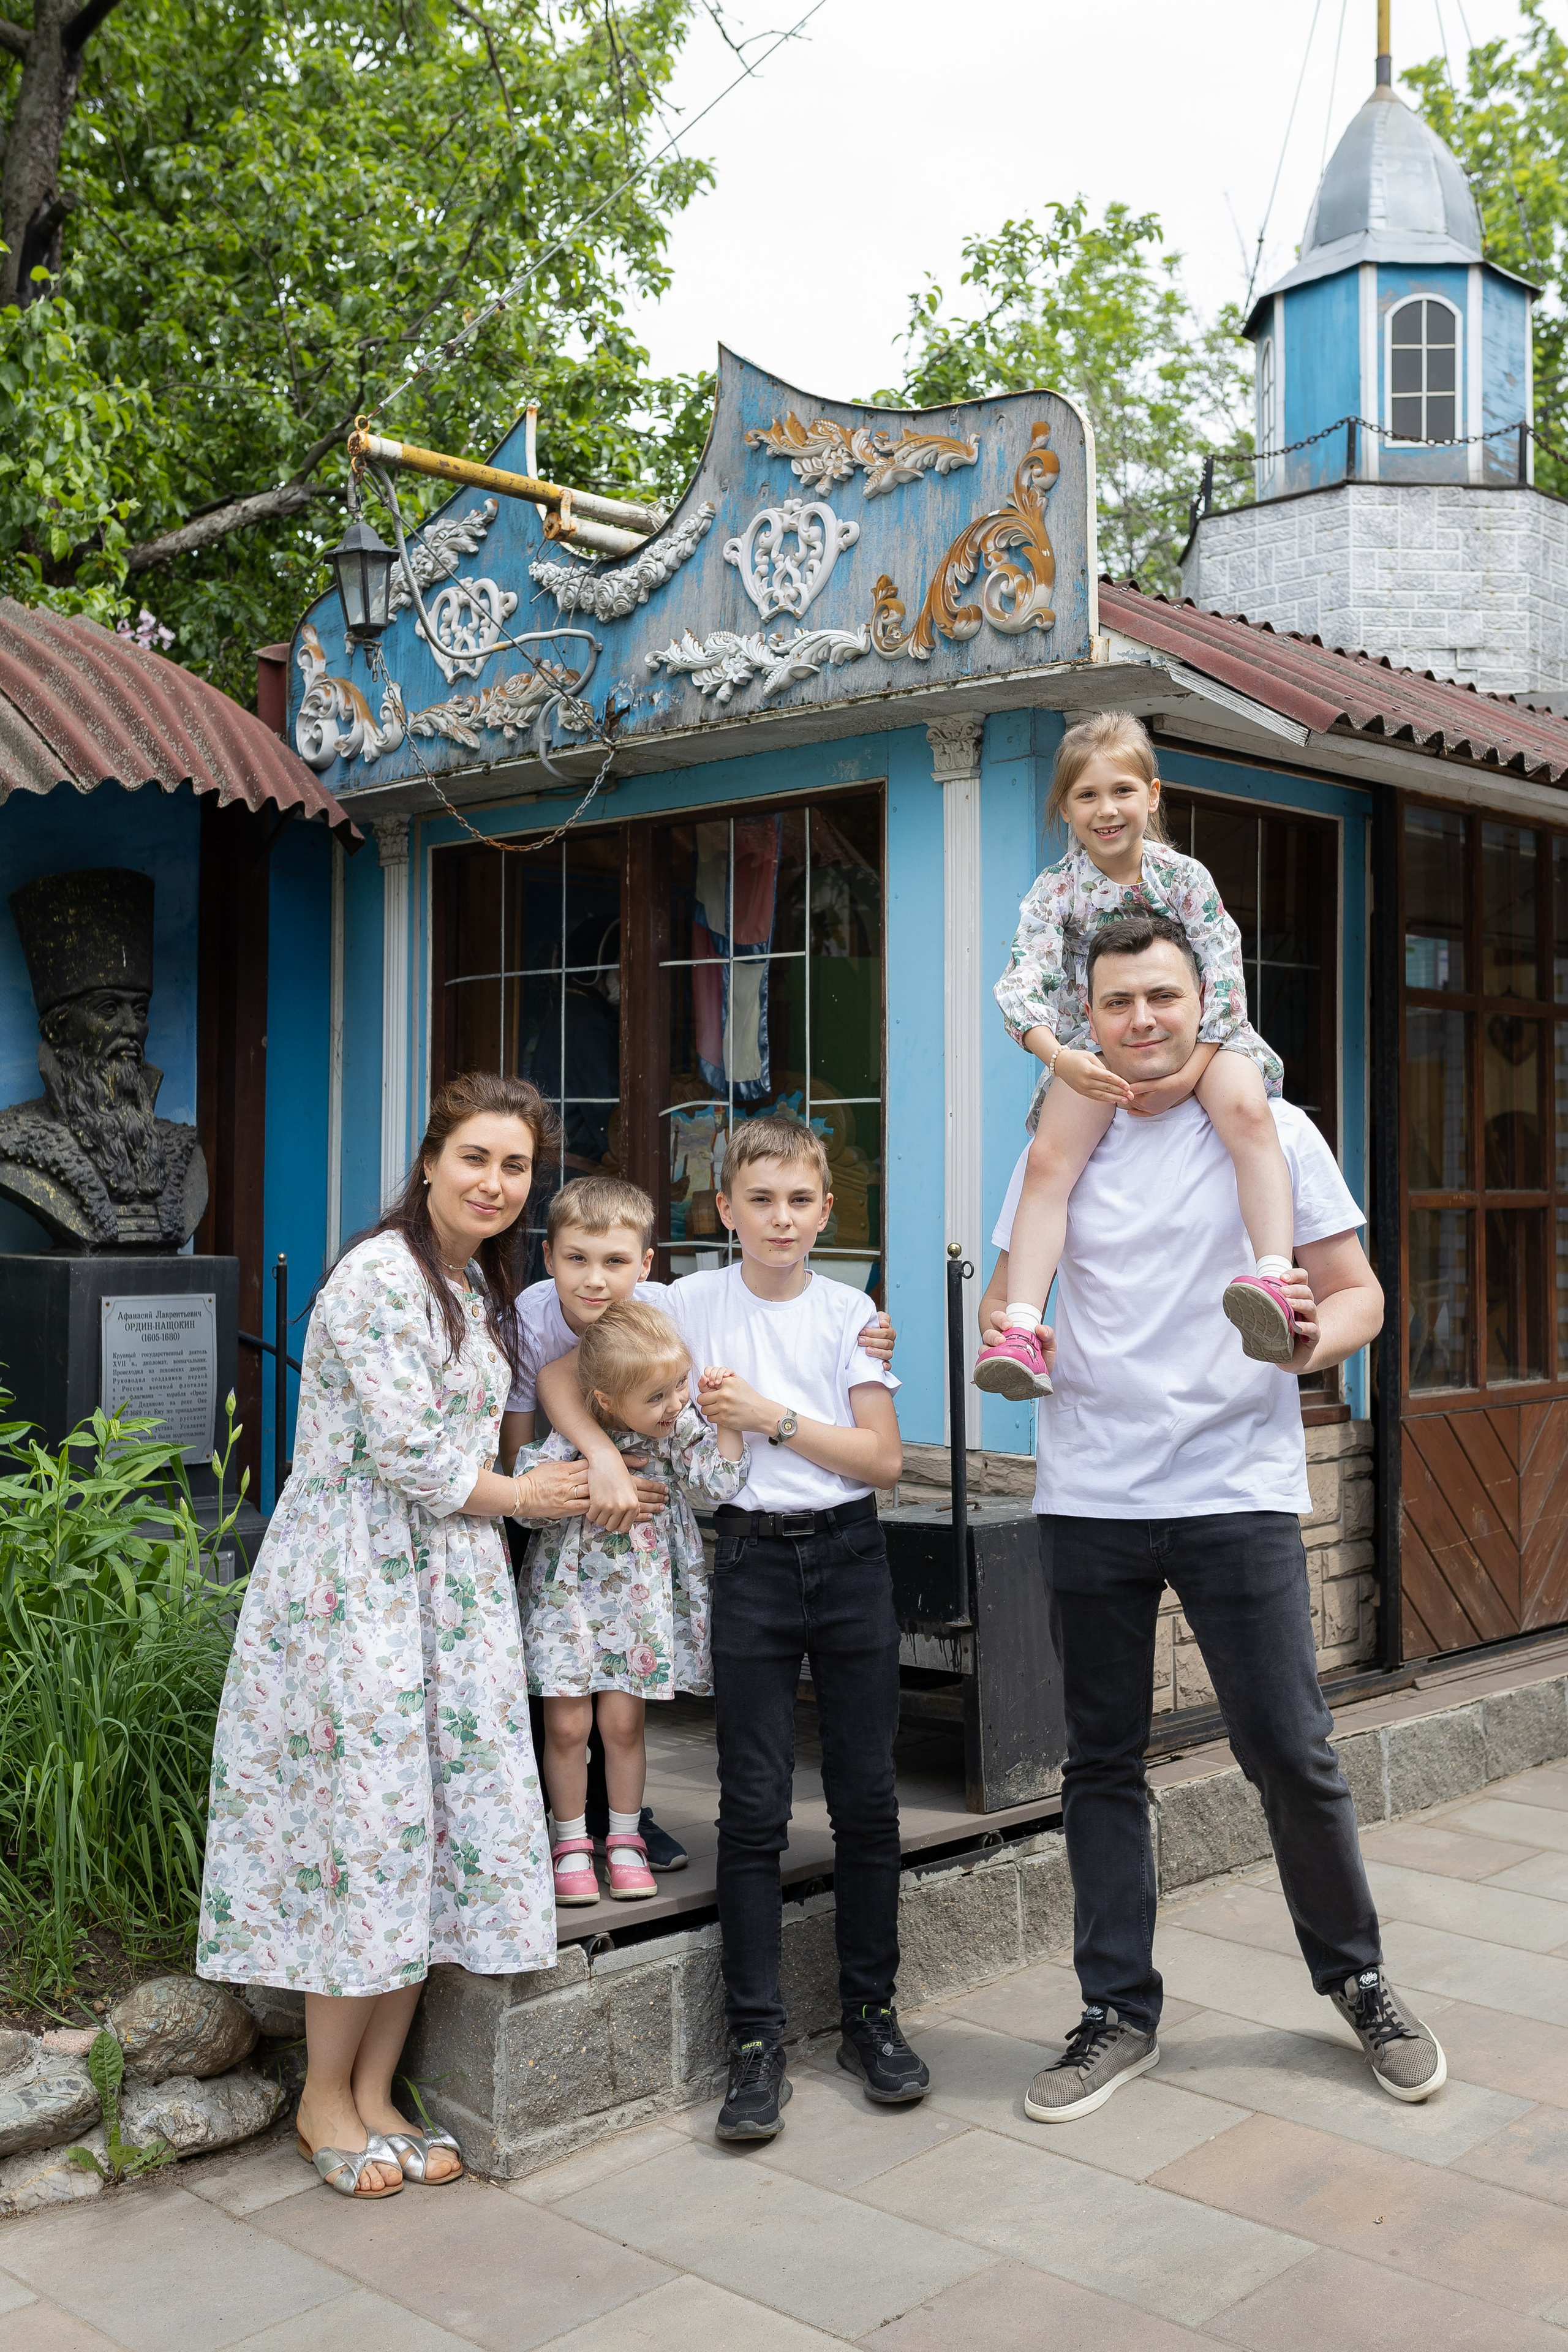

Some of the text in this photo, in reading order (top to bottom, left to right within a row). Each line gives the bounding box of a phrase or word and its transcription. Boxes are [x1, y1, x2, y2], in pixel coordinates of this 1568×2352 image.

[118, 1310, 202, 1321] Афанасий Лаврентьевич
[124, 1321, 195, 1332] ОРДИН-НАЩОКИН
[141, 1332, 180, 1343] (1605-1680)
[141, 1349, 183, 1359] государственный
